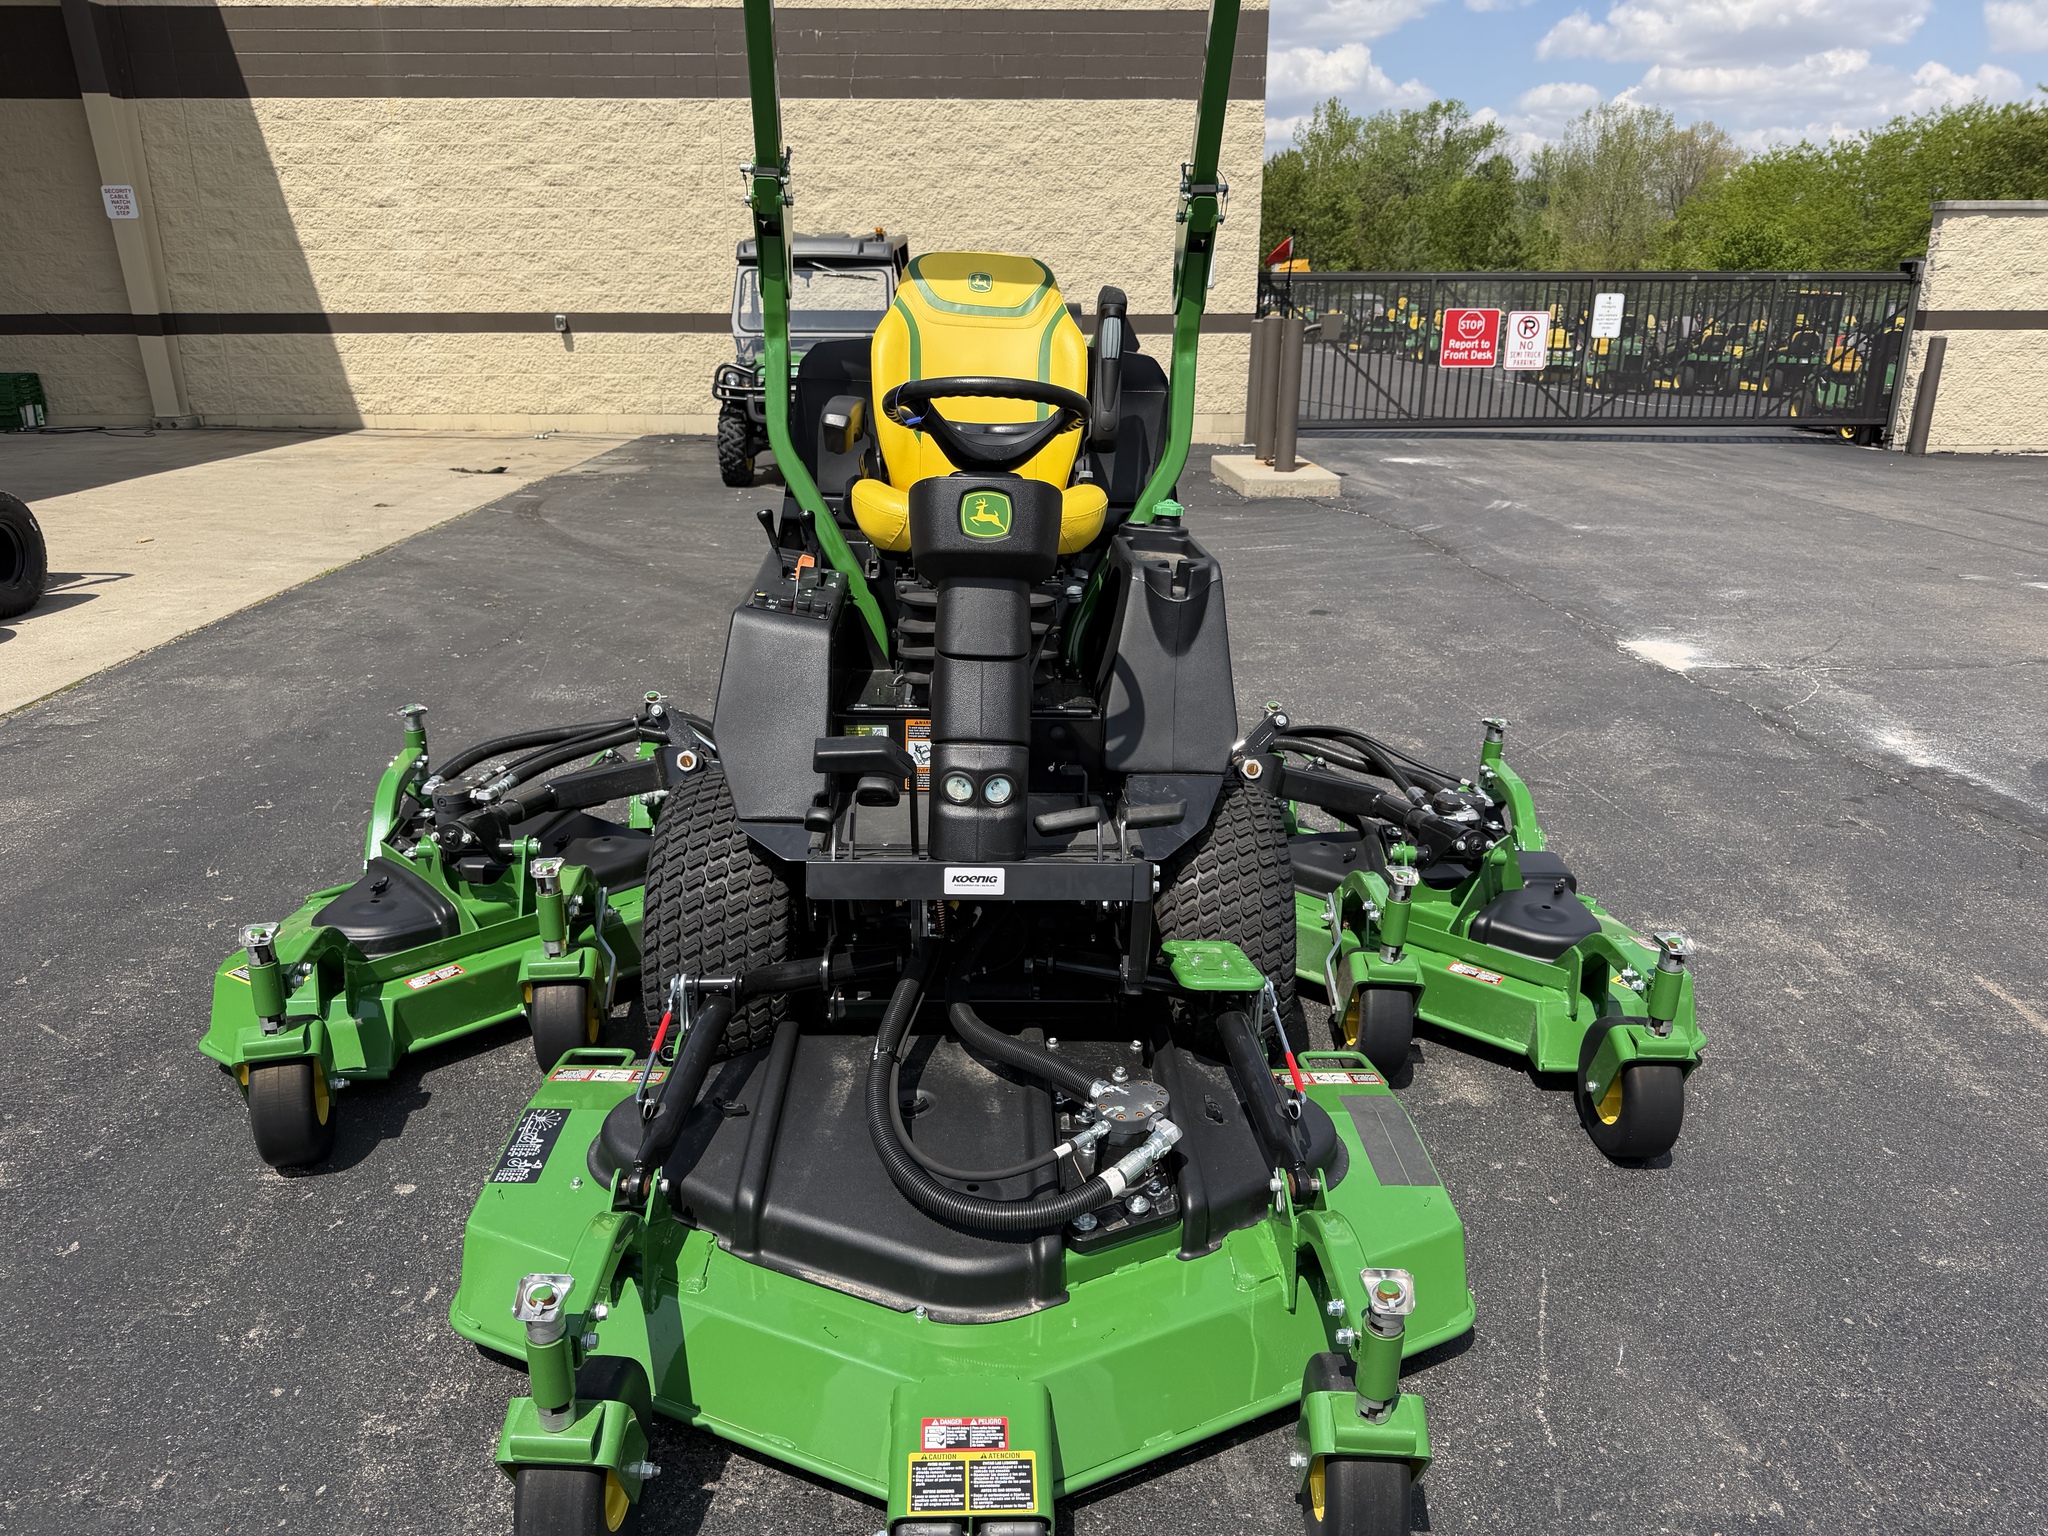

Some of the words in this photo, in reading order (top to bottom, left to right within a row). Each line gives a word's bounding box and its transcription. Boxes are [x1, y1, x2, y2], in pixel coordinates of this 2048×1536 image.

[1460, 320, 1483, 330] STOP
[1449, 339, 1479, 349] Report
[1481, 340, 1490, 349] to
[1519, 341, 1534, 349] NO
[1444, 350, 1469, 360] Front
[1470, 351, 1492, 360] Desk
